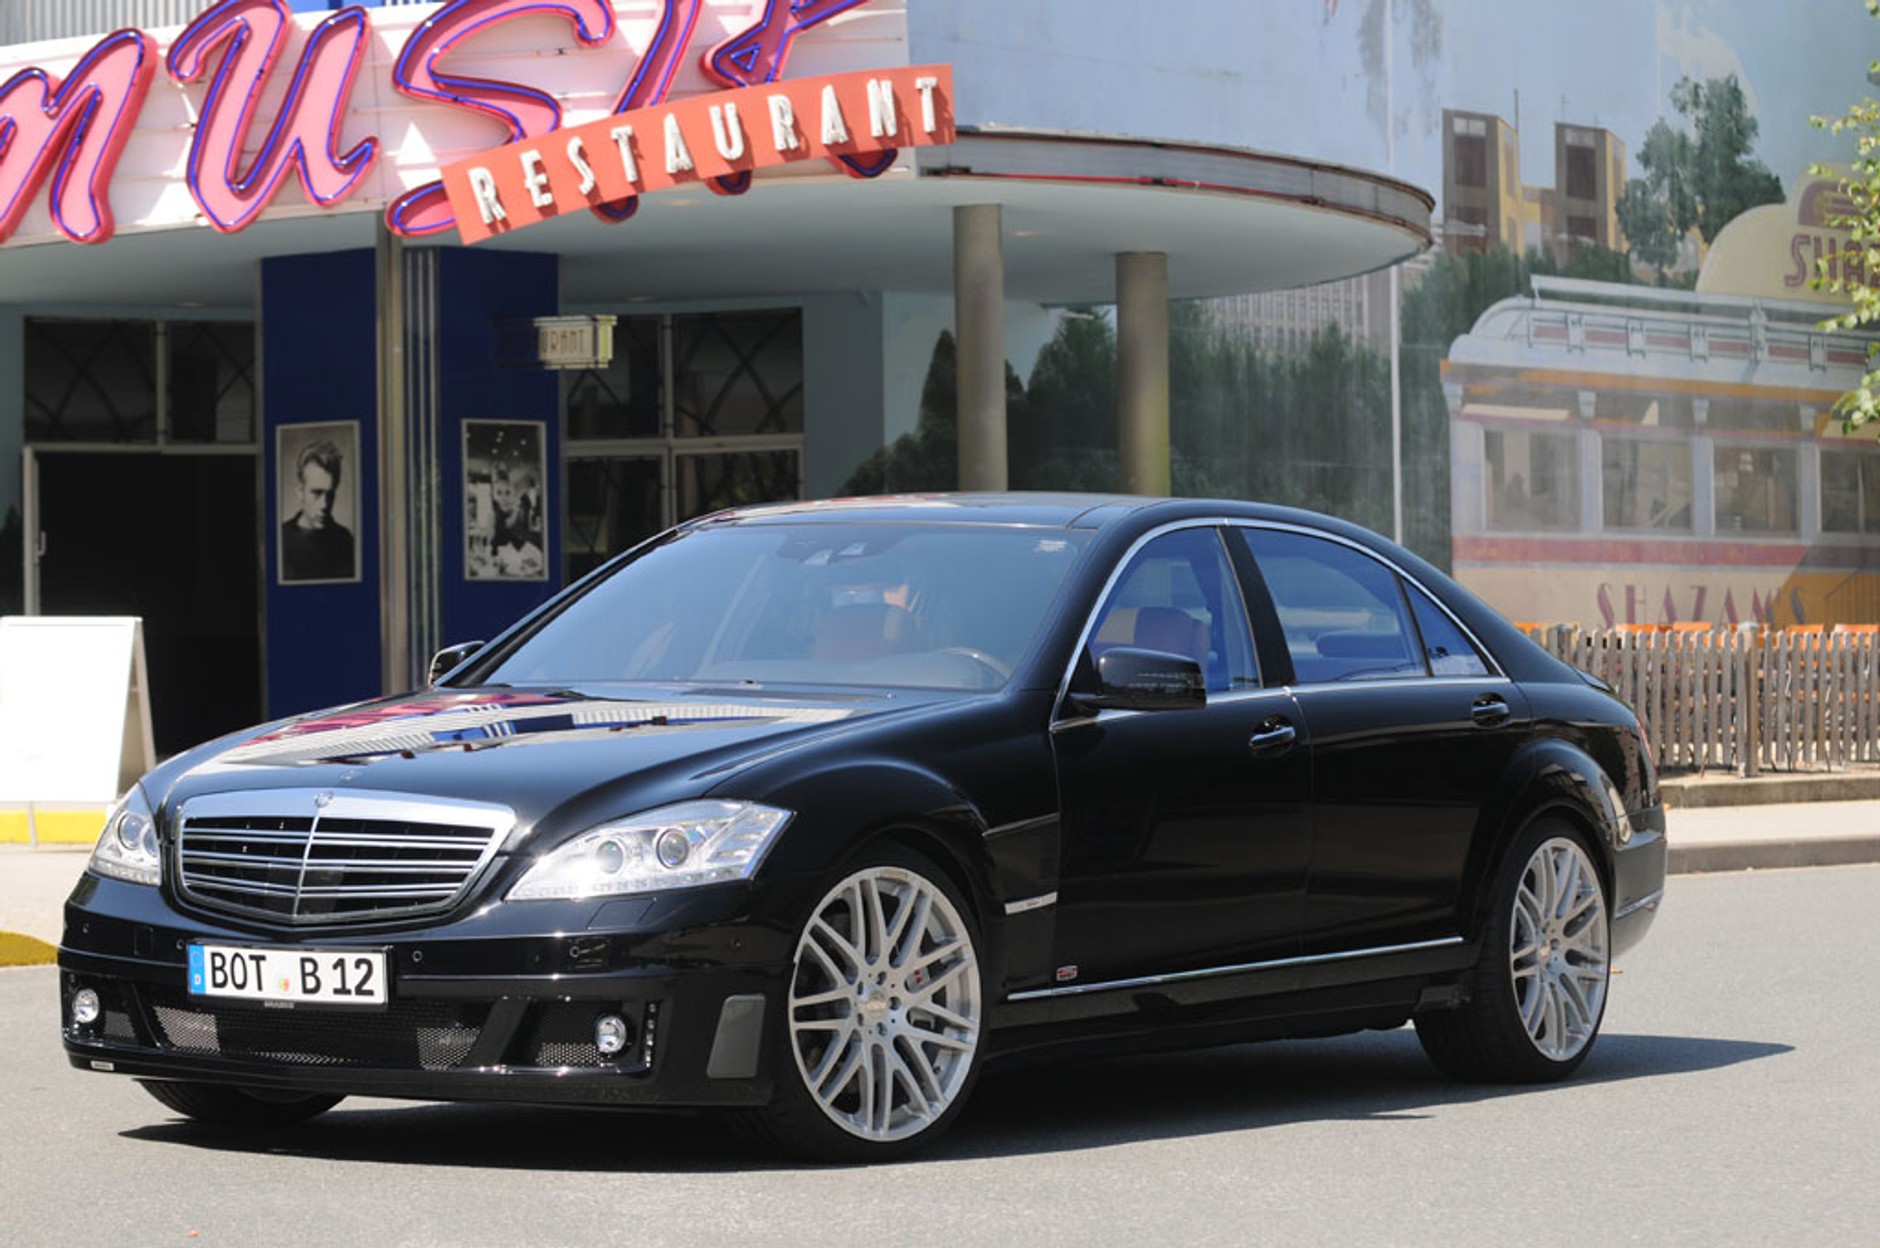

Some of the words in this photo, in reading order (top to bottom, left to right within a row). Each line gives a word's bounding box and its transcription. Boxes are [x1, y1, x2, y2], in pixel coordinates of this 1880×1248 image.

[468, 77, 938, 224] RESTAURANT
[211, 952, 266, 991] BOT
[300, 957, 321, 994] B
[332, 958, 374, 996] 12
